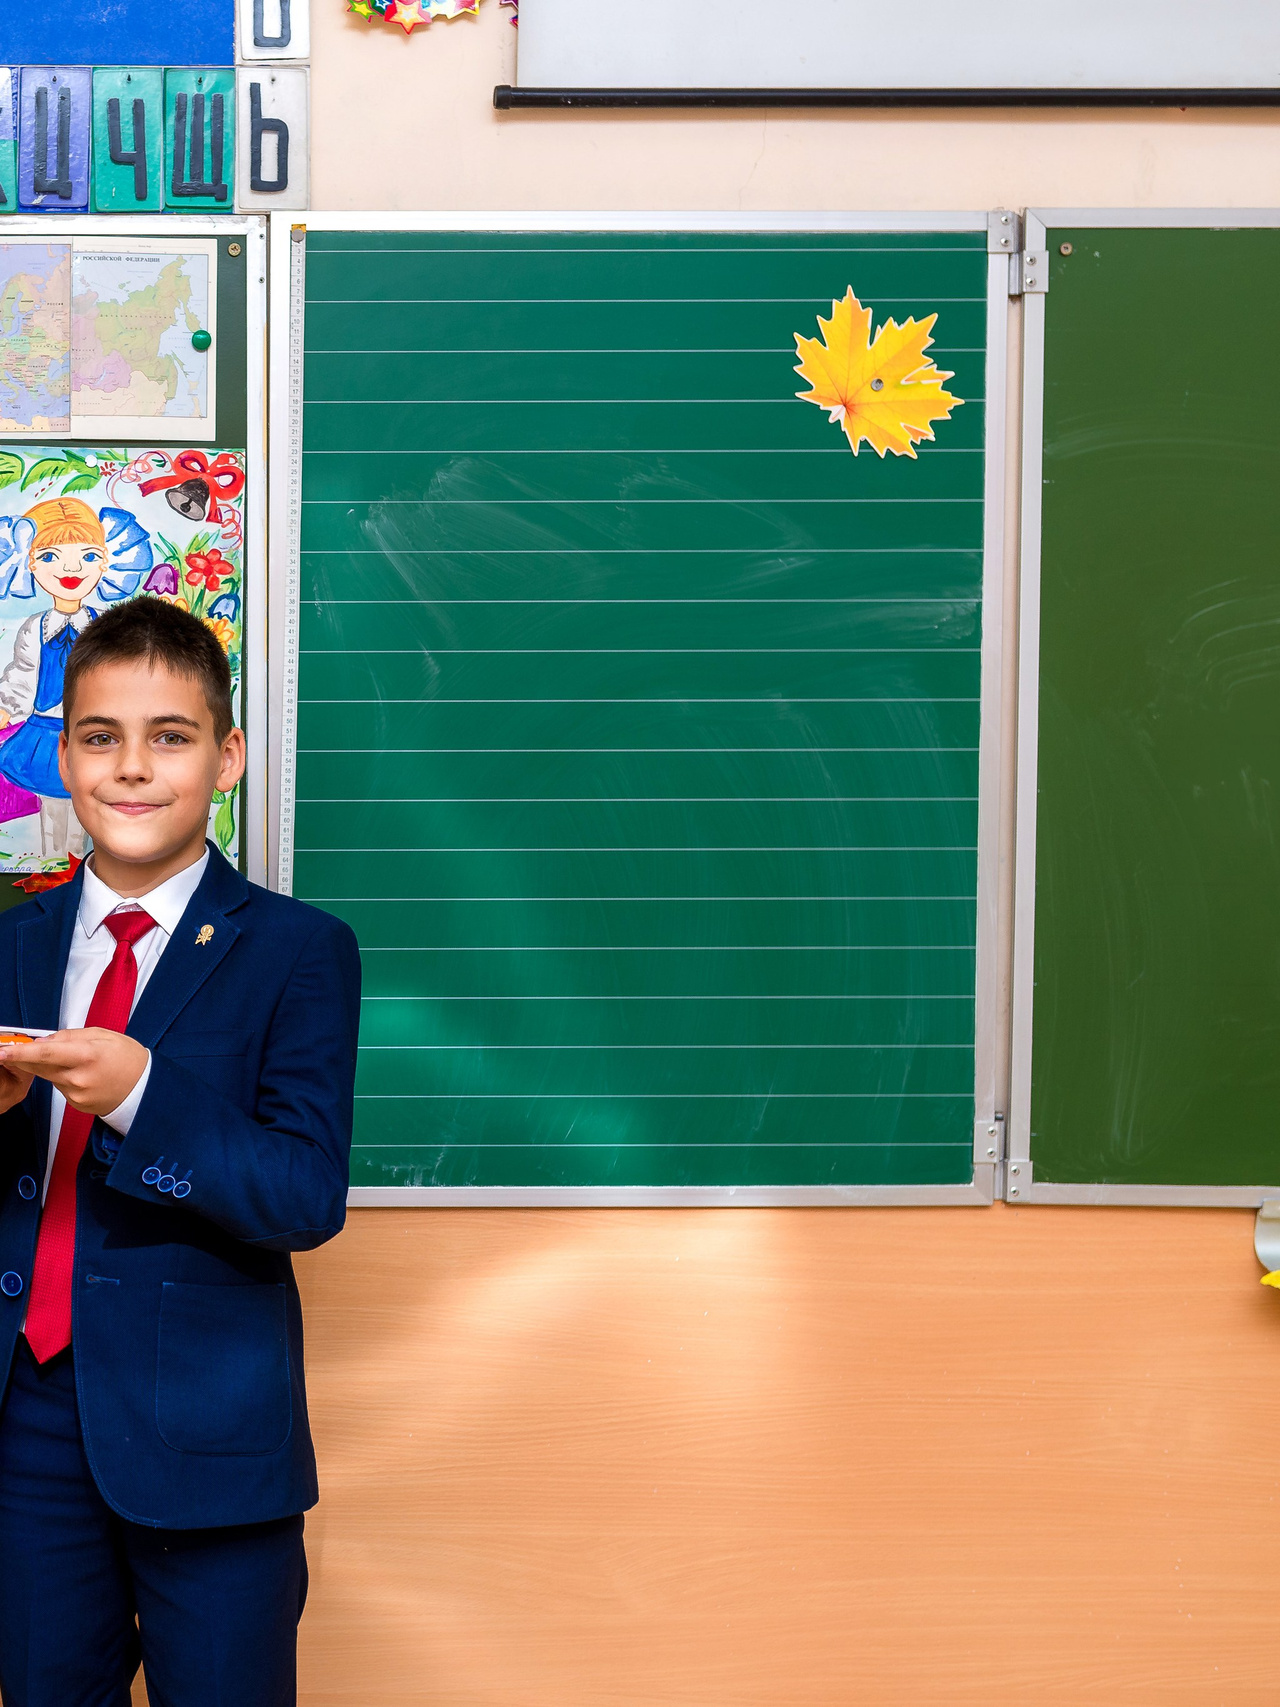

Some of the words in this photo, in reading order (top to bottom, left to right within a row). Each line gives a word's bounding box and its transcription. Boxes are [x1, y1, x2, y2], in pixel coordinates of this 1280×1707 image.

[33, 86, 73, 200] Ц
[107, 98, 148, 200] Ч
[172, 92, 228, 201] Щ
[250, 82, 289, 192] Ь
